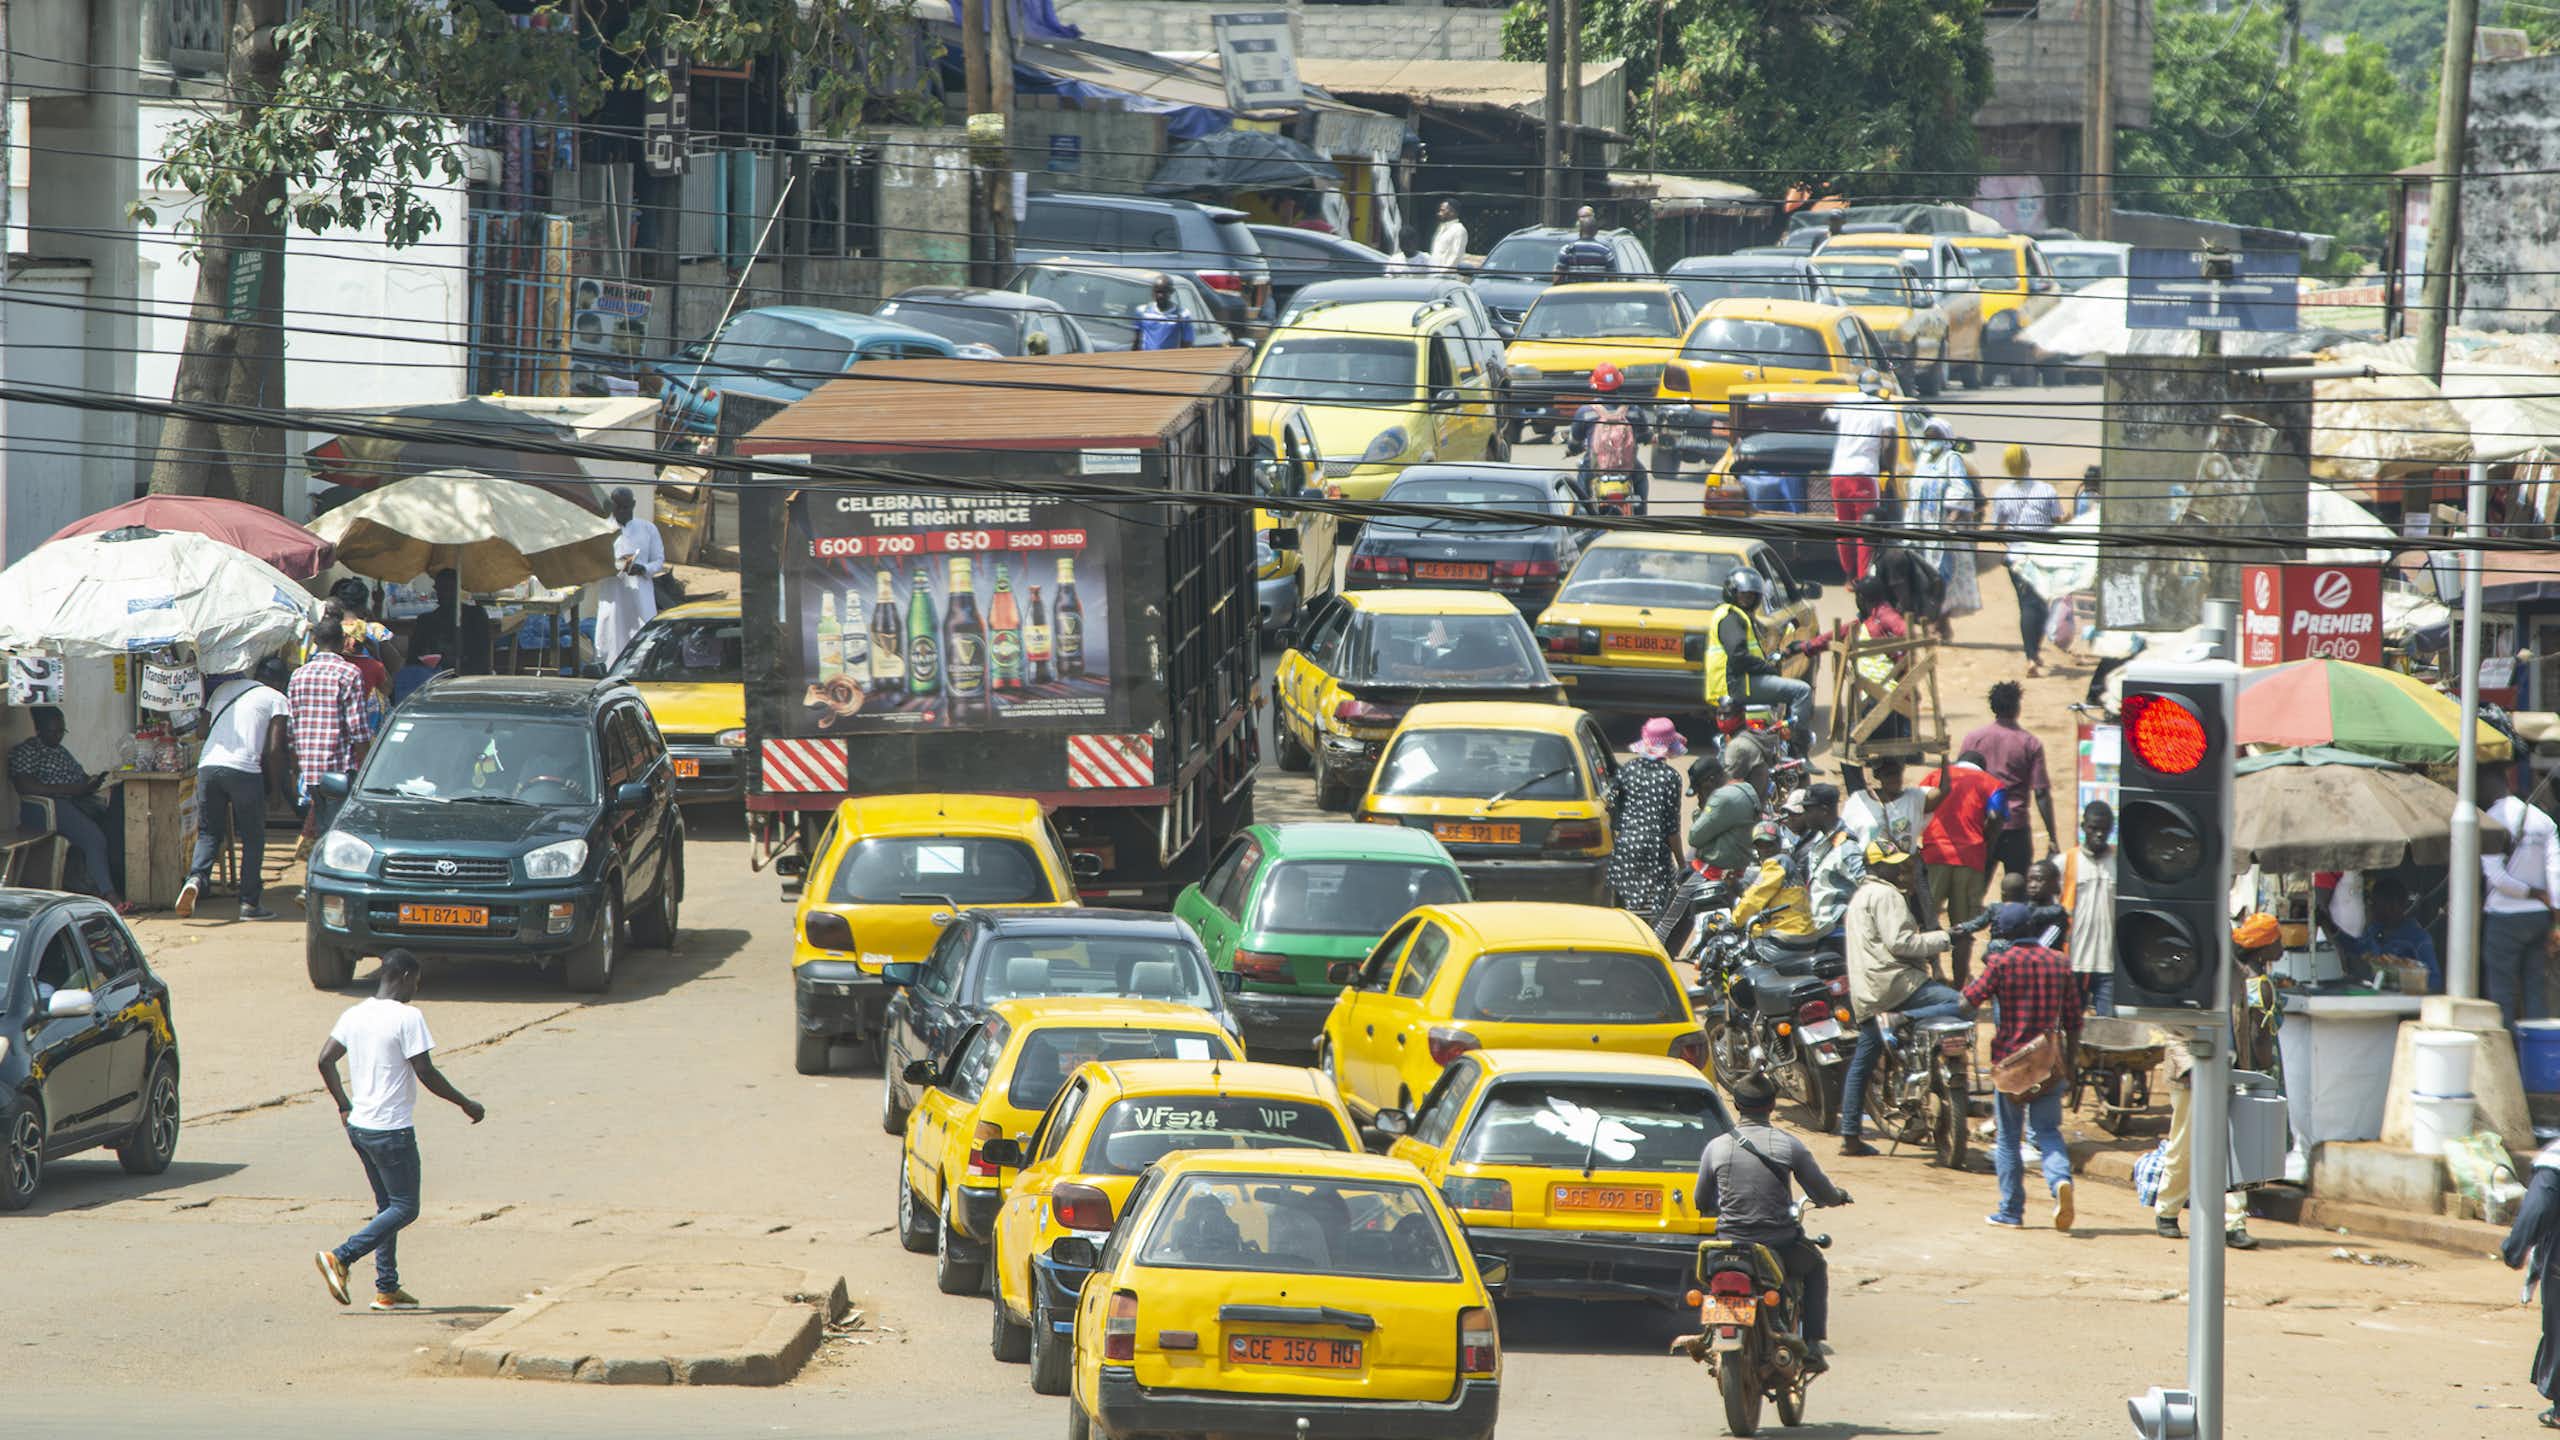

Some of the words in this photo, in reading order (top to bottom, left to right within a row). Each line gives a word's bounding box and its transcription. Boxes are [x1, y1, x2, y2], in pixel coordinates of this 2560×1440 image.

[836, 494, 947, 512] CELEBRATE
[951, 492, 1002, 509] WITH
[871, 511, 909, 528] THE
[912, 509, 971, 527] RIGHT
[973, 507, 1031, 525] PRICE
[820, 537, 863, 556] 600
[876, 536, 916, 553] 700
[944, 531, 990, 550] 650
[1008, 533, 1043, 548] 500
[1052, 532, 1084, 546] 1050
[2292, 610, 2374, 636] PREMIER
[2306, 635, 2360, 660] Loto
[16, 659, 50, 704] 25
[174, 672, 182, 684] de
[143, 690, 173, 706] Orange
[182, 692, 200, 703] MTN
[433, 908, 459, 923] 871
[1259, 1107, 1298, 1129] VIP
[1571, 1190, 1591, 1206] CE
[1250, 1339, 1272, 1360] CE
[1283, 1341, 1317, 1362] 156
